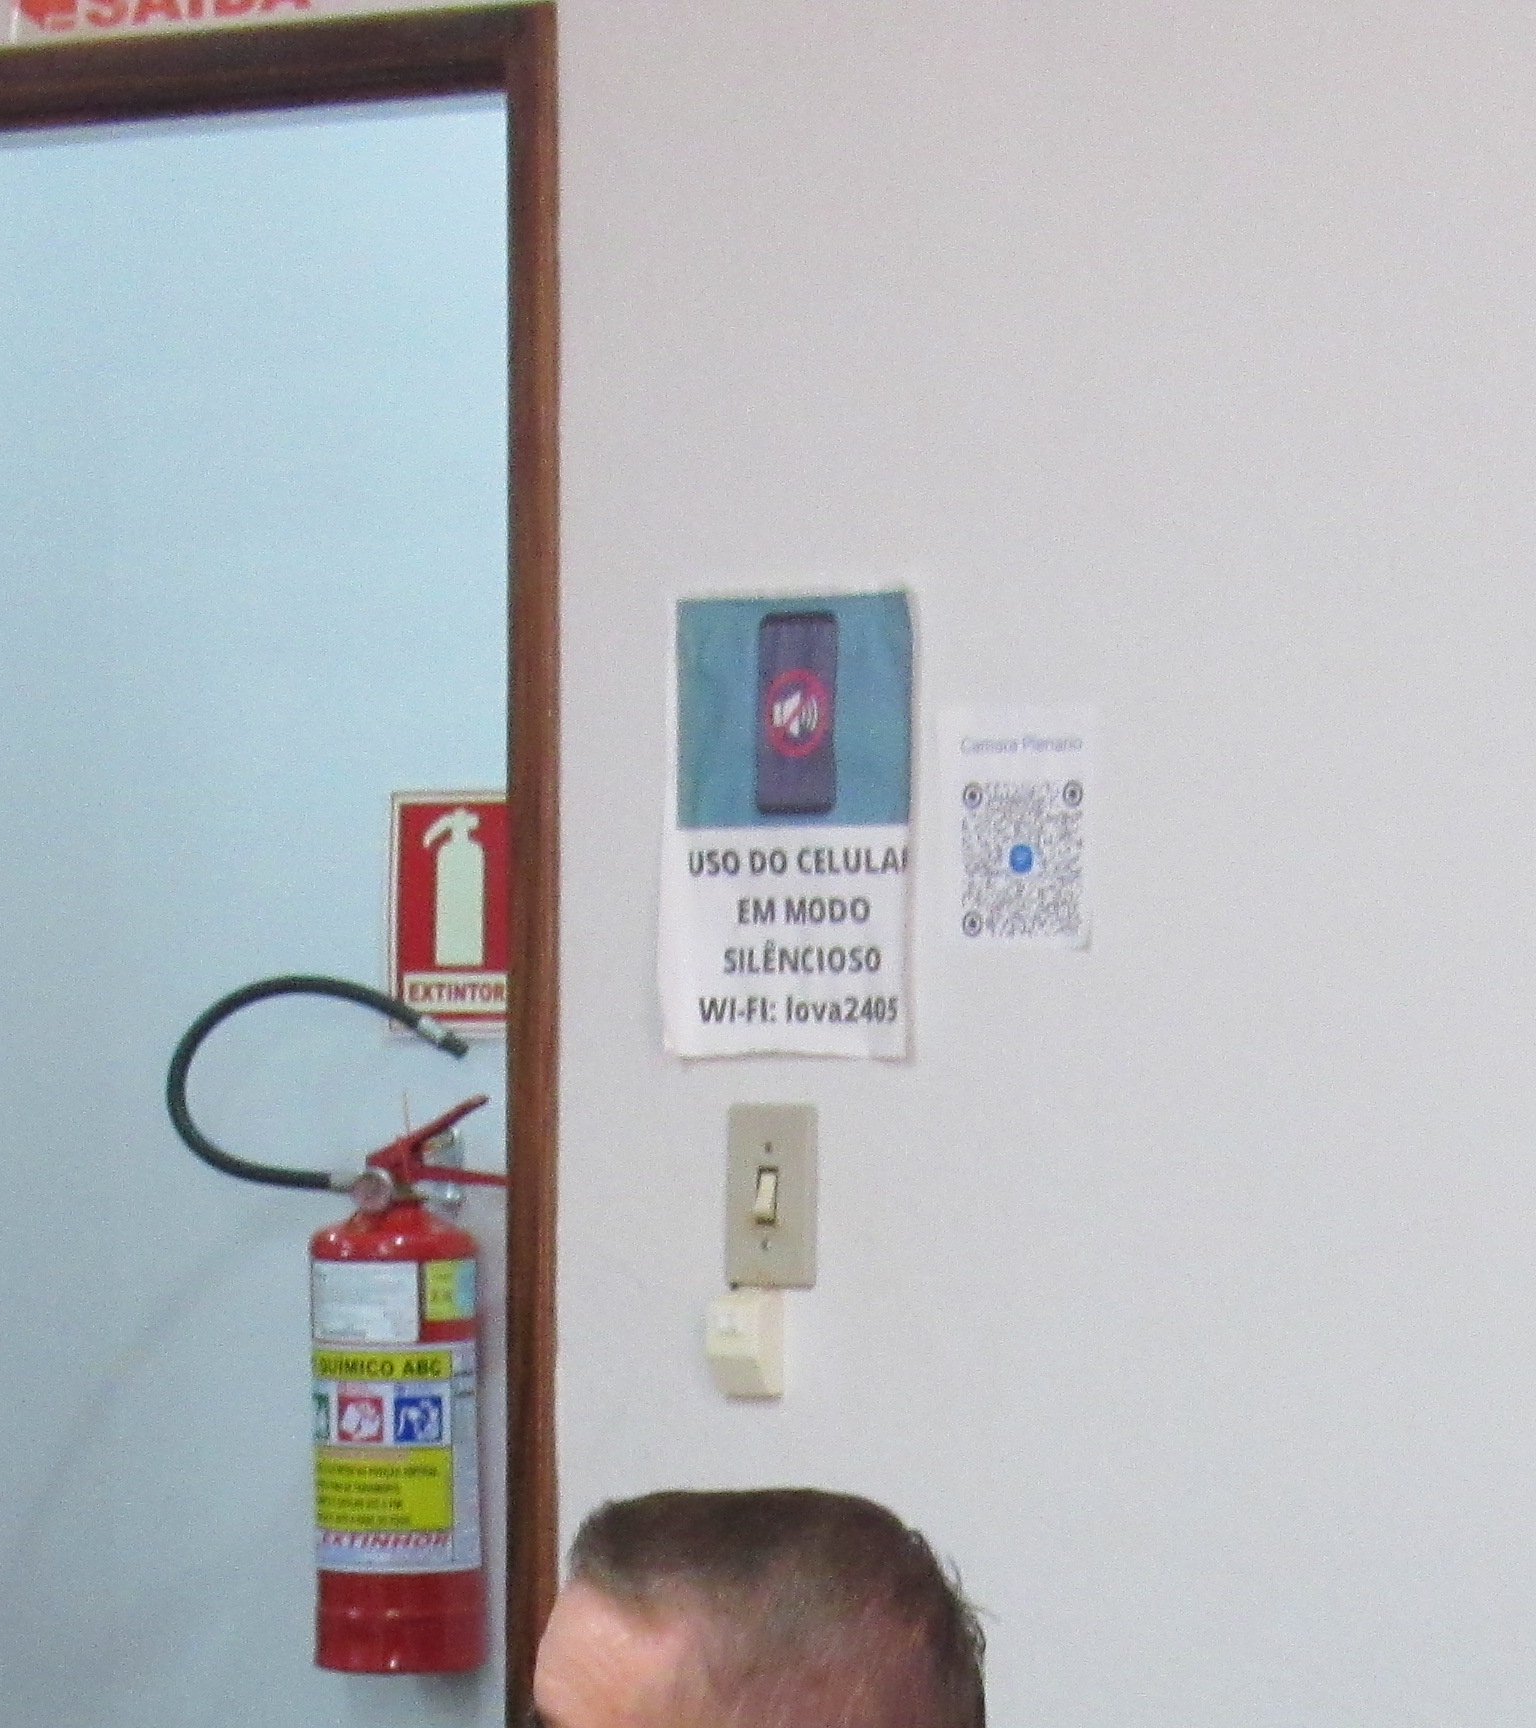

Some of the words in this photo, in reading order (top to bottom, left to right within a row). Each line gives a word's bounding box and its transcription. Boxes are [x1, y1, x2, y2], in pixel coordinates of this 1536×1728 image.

[688, 849, 740, 876] USO
[750, 849, 787, 875] DO
[738, 898, 776, 924] EM
[785, 897, 871, 924] MODO
[724, 940, 882, 974] SILÊNCIOSO
[699, 997, 777, 1023] WI-FI:
[402, 1358, 442, 1377] ABC
